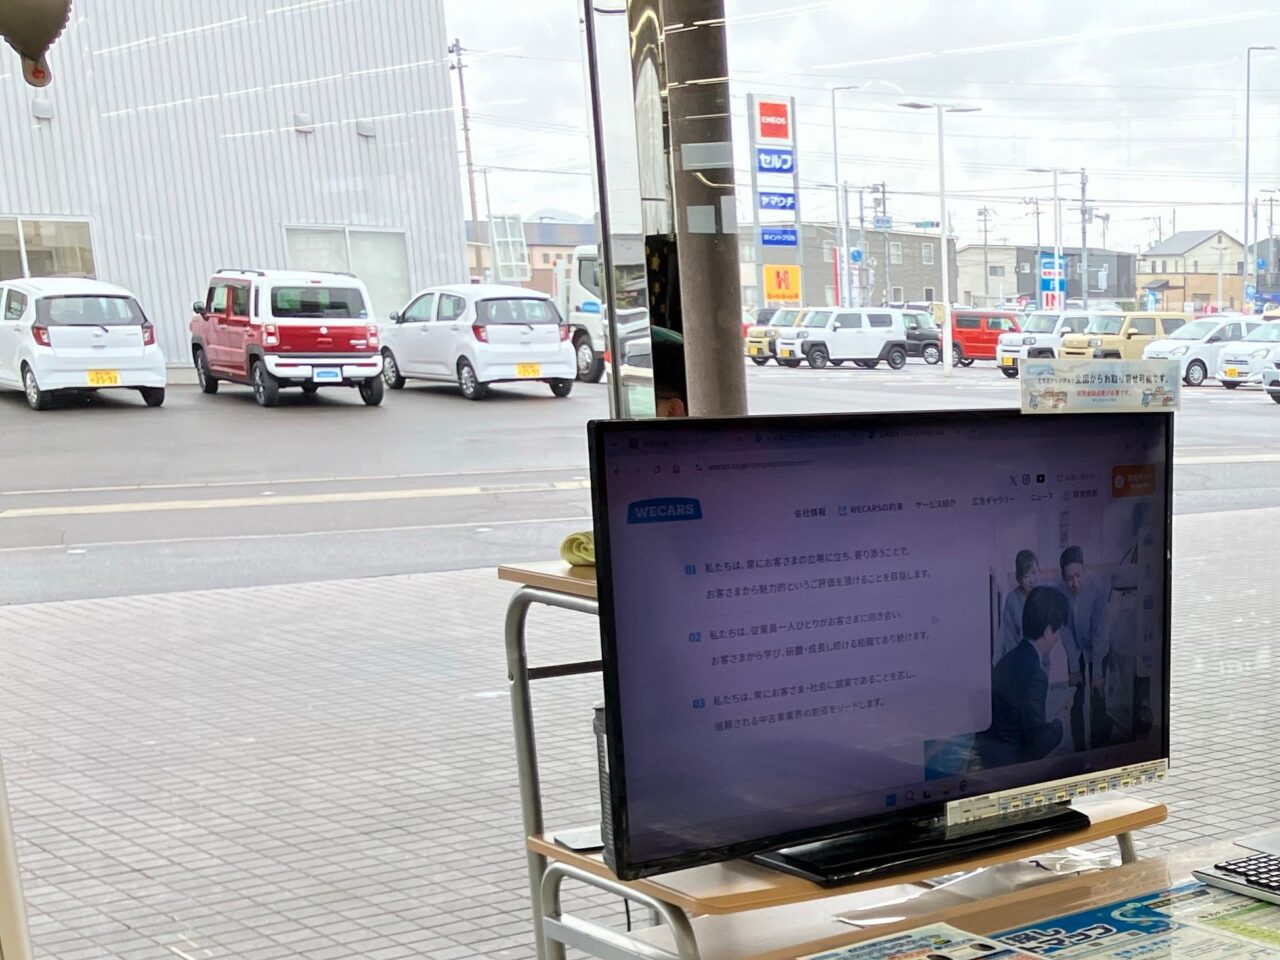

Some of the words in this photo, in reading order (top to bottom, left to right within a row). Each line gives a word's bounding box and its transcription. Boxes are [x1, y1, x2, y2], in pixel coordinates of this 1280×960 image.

[761, 115, 787, 125] ENEOS
[760, 153, 793, 170] セルフ
[635, 503, 694, 518] WECARS
[794, 506, 826, 518] 会社情報
[685, 564, 697, 576] 01
[689, 632, 701, 643] 02
